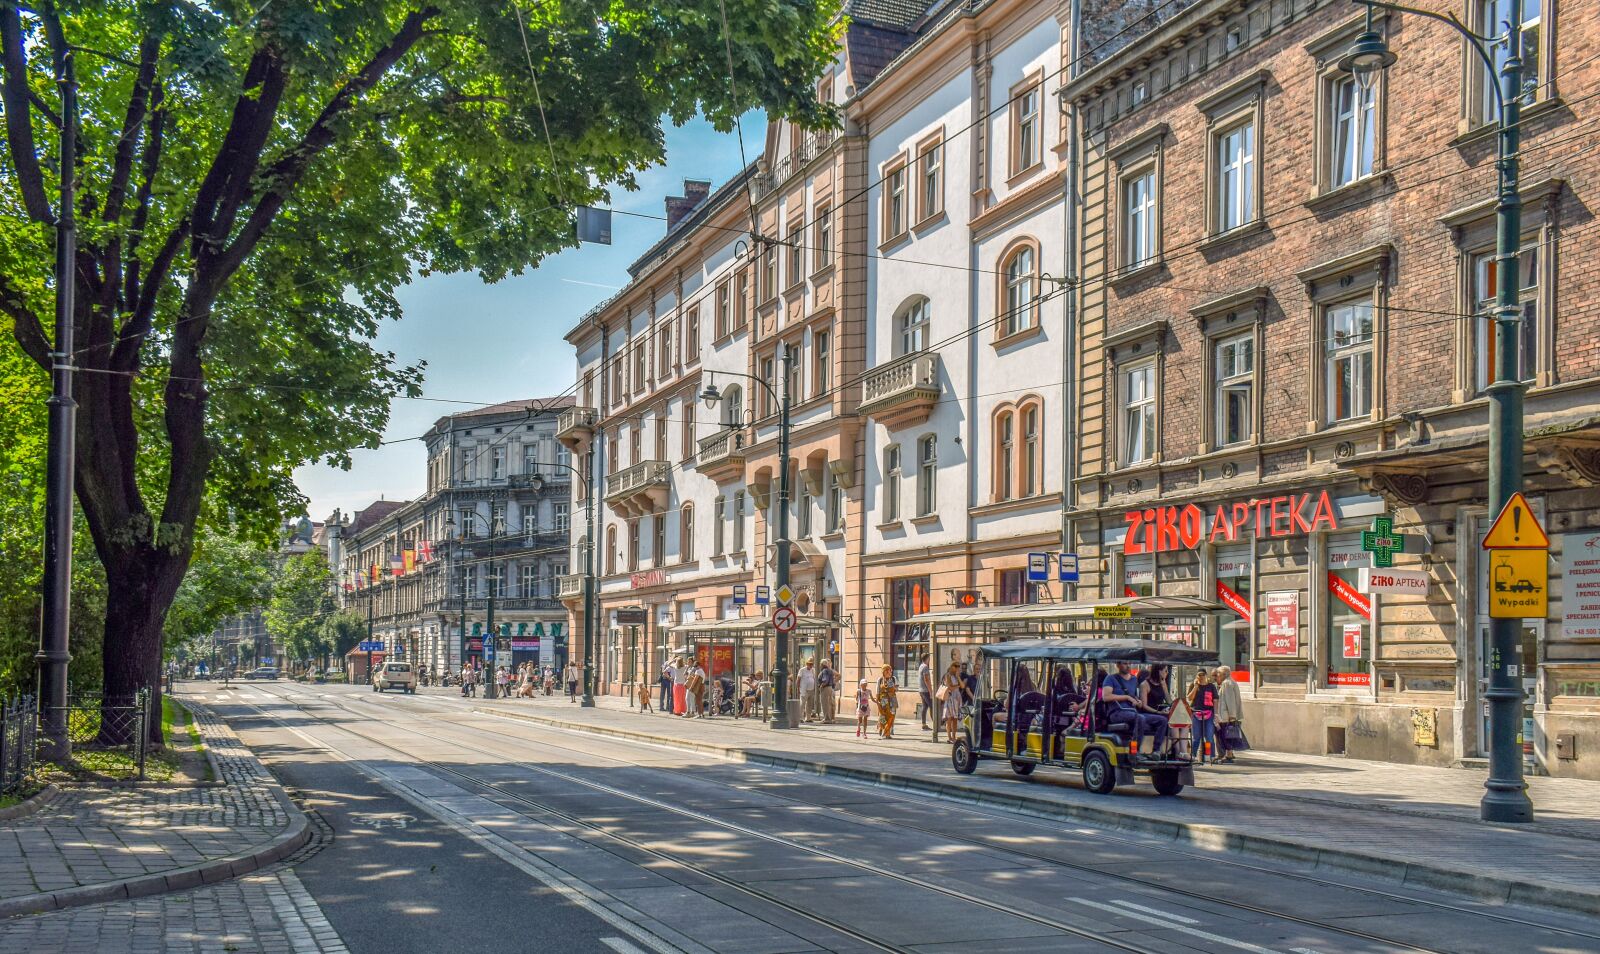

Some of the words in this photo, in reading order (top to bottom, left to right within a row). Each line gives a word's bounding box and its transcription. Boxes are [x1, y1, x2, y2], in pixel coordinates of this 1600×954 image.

[1210, 490, 1337, 543] APTEKA
[1395, 578, 1426, 588] APTEKA
[1499, 598, 1539, 607] Wypadki
[471, 621, 563, 637] EEFAN
